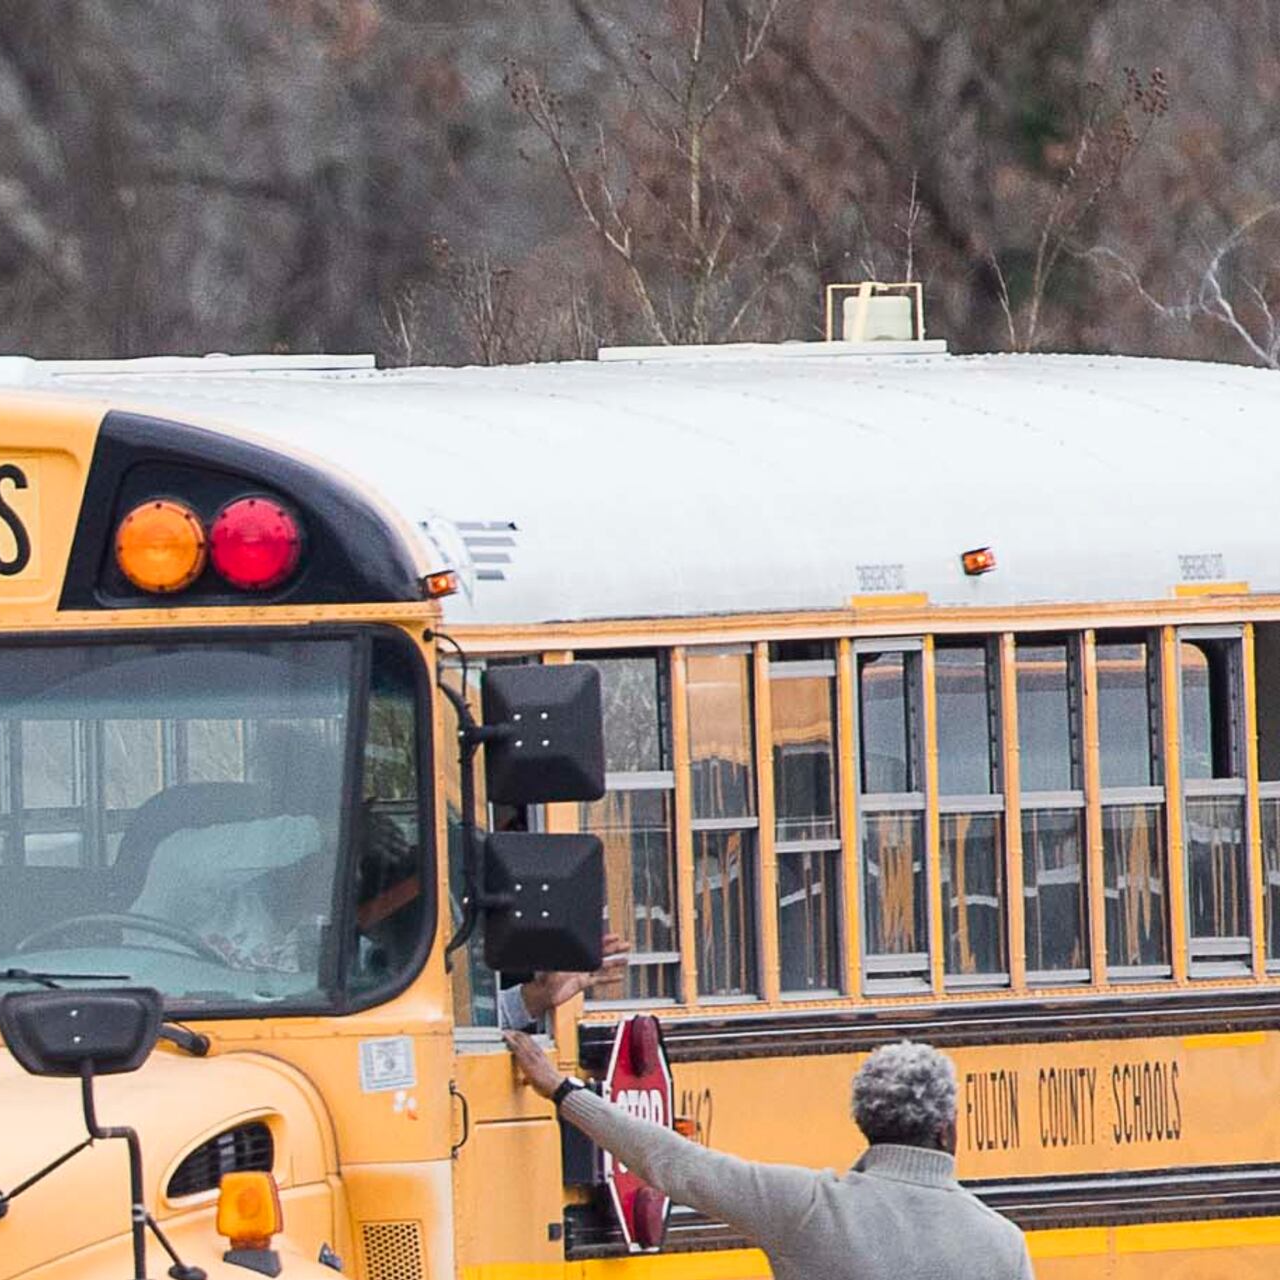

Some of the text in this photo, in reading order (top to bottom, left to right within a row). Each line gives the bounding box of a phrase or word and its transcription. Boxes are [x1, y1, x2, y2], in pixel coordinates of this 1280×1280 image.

[966, 1060, 1182, 1150] FULTON COUNTY SCHOOLS
